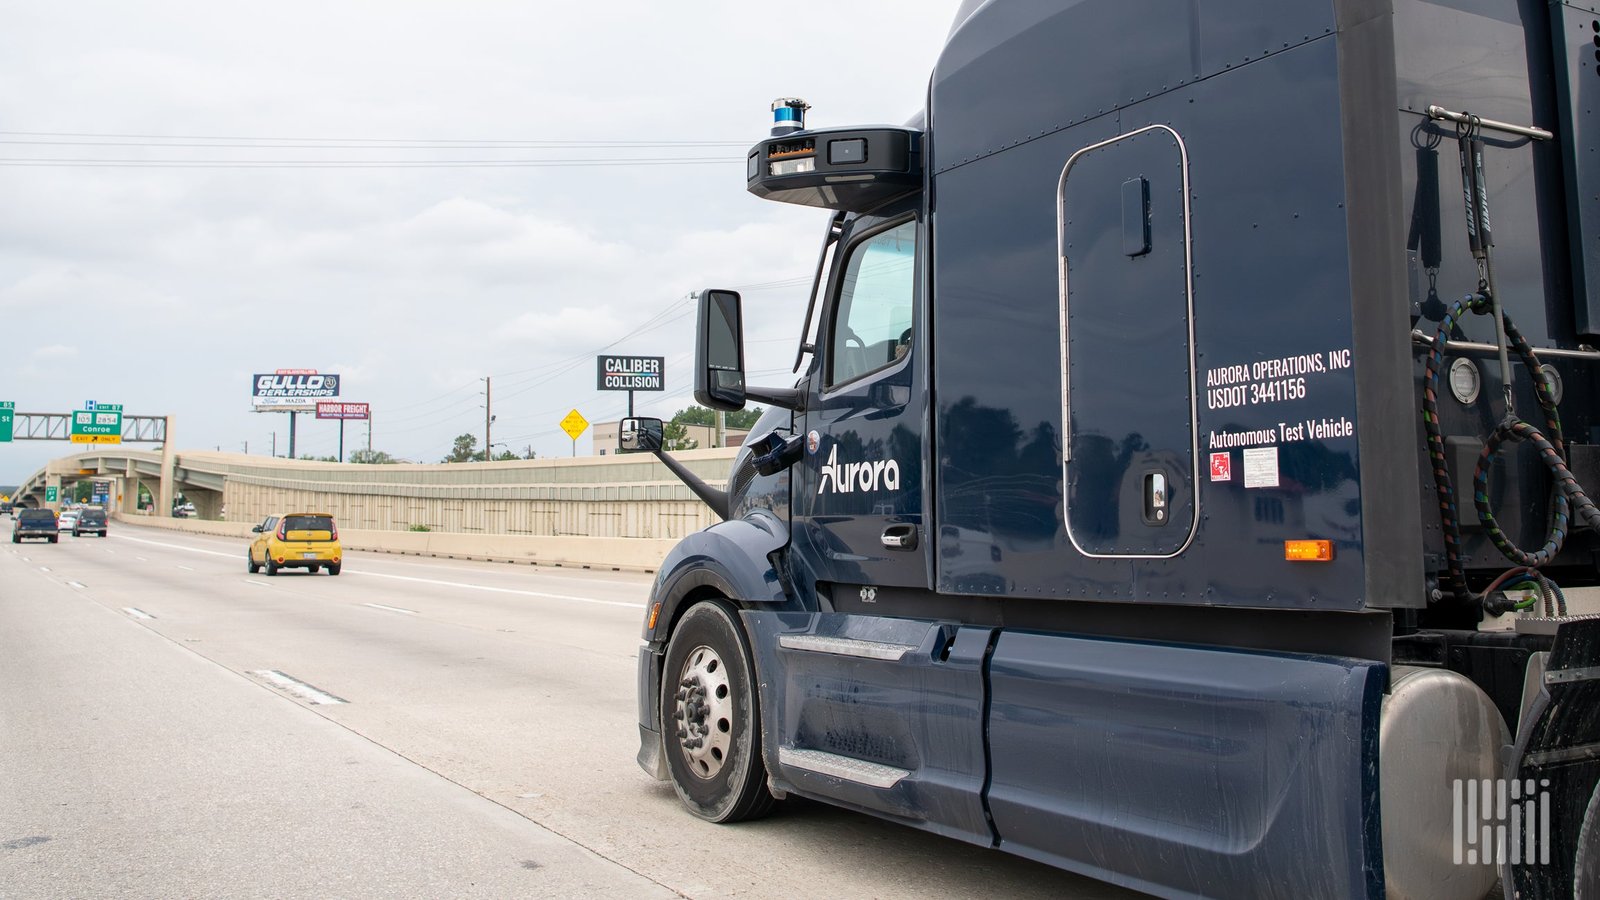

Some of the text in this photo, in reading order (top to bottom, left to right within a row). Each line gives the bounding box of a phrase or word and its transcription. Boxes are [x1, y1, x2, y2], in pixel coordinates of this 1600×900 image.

[1464, 188, 1476, 236] TRACKER
[1480, 187, 1491, 232] TRACKER
[605, 358, 660, 373] CALIBER
[1207, 349, 1351, 387] AURORA OPERATIONS, INC
[257, 375, 325, 389] GULLO
[605, 376, 660, 388] COLLISION
[1208, 378, 1306, 409] USDOT 3441156
[318, 403, 368, 414] HARBOR FREIGHT
[1209, 417, 1353, 449] Autonomous Test Vehicle
[818, 443, 900, 494] Aurora
